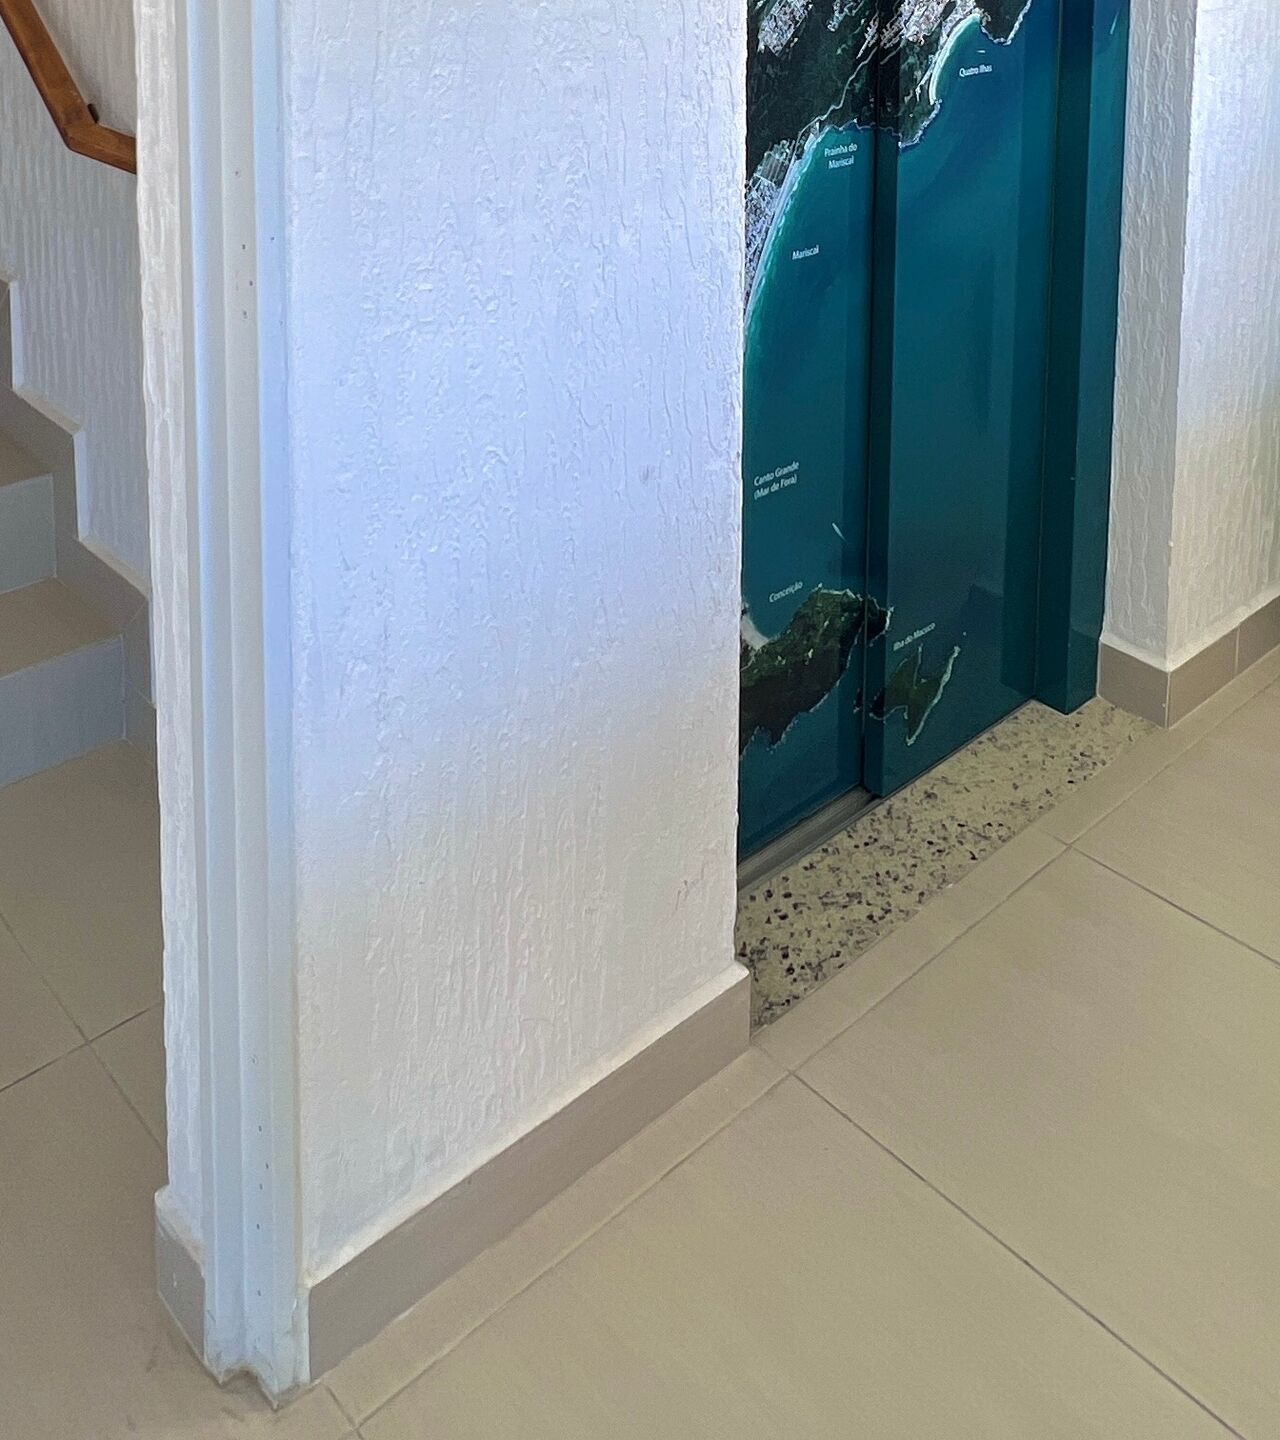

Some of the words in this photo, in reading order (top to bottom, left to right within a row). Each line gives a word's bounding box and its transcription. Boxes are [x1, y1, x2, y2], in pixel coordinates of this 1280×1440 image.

[824, 145, 848, 158] Prainha
[848, 143, 858, 153] do
[828, 155, 855, 169] Mariscal
[792, 245, 820, 261] Mariscal
[753, 472, 775, 487] Canto
[774, 460, 800, 478] Grande
